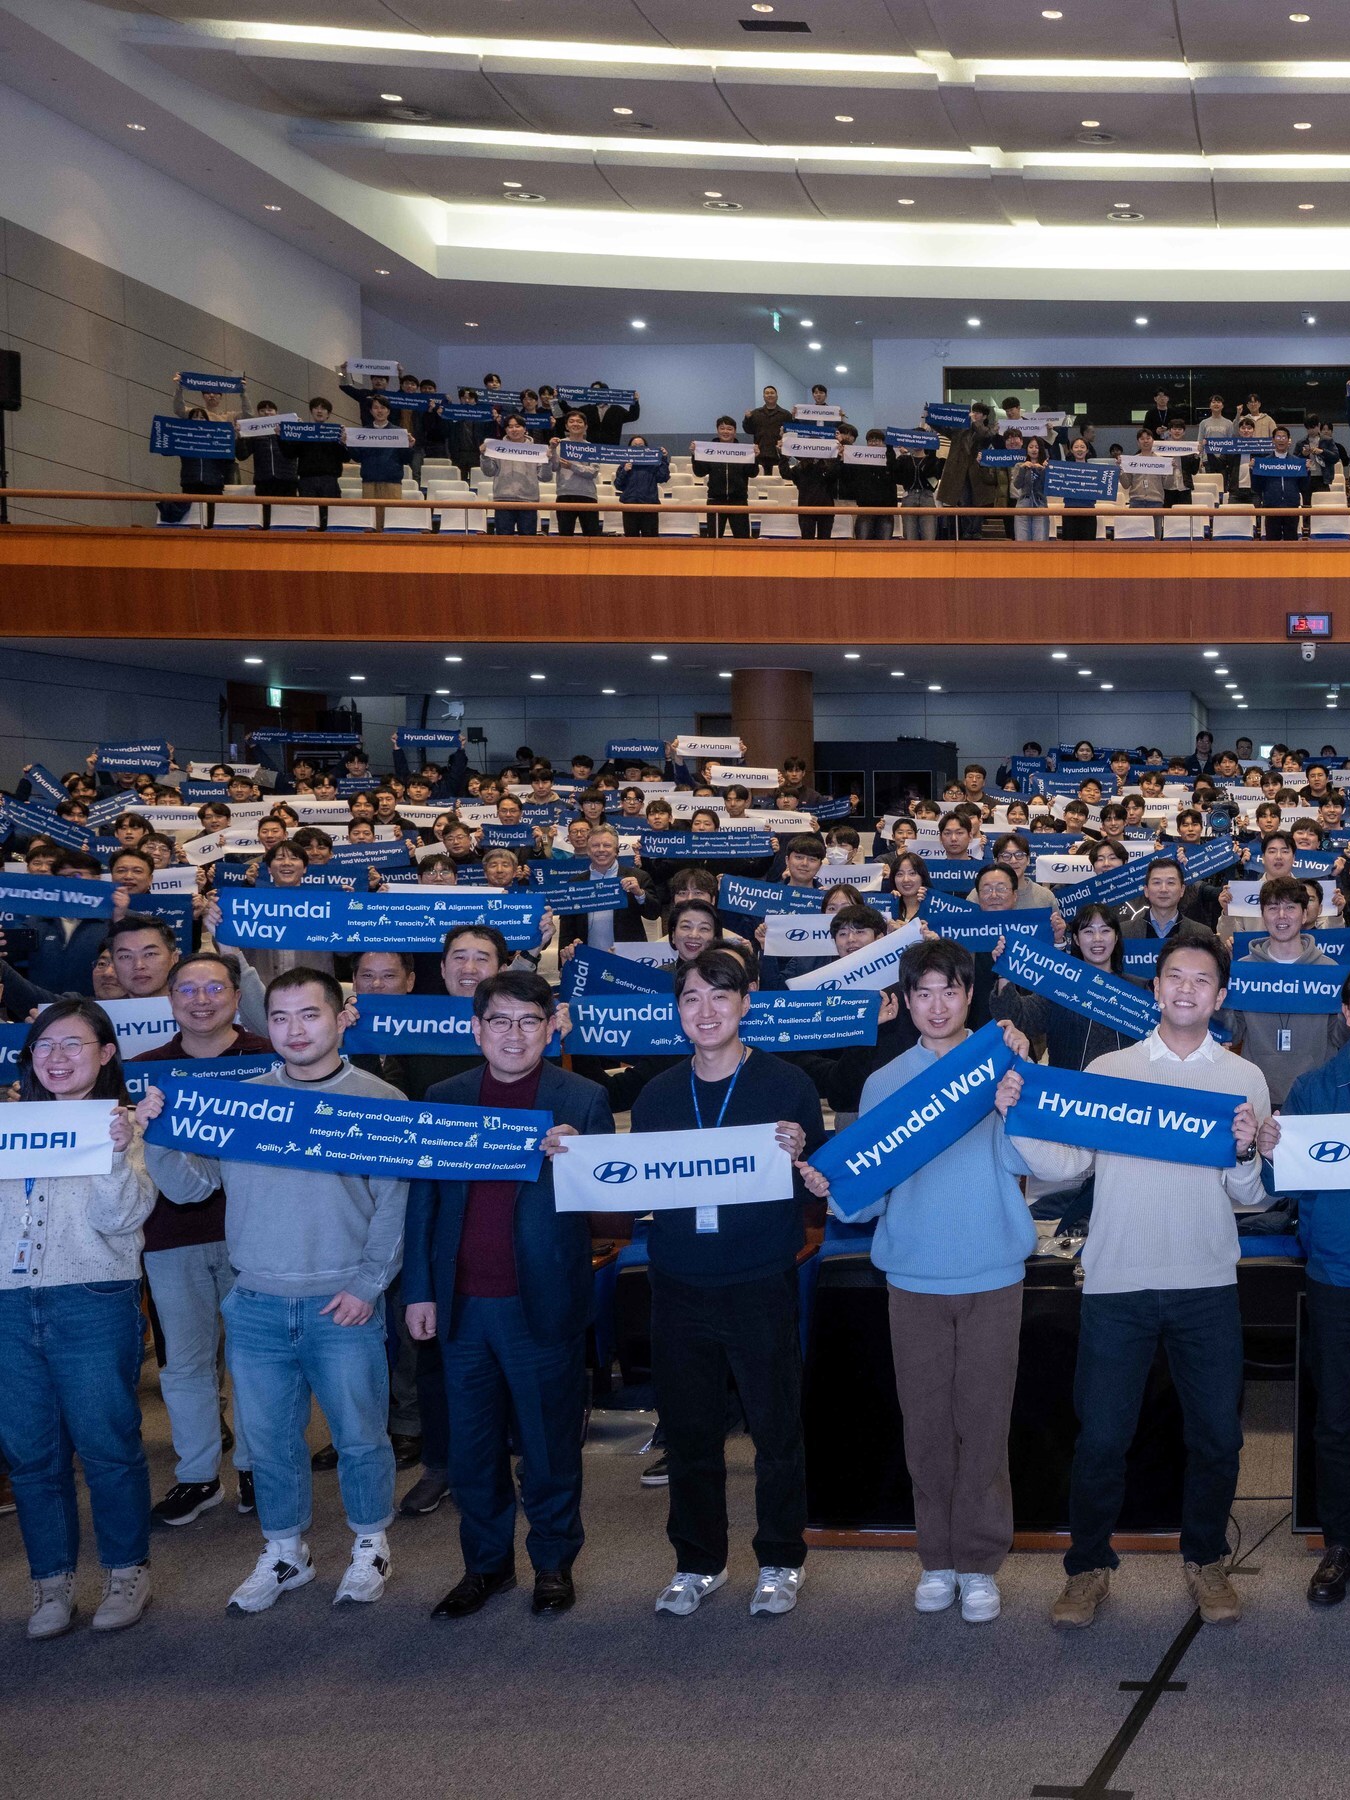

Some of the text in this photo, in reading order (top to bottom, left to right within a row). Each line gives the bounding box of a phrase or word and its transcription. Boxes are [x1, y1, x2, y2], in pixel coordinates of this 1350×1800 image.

[186, 378, 236, 389] Hyundai Way
[283, 424, 316, 434] Hyundai
[284, 430, 302, 439] Way
[565, 444, 596, 454] Hyundai
[1208, 440, 1233, 449] Hyundai
[566, 450, 583, 460] Way
[1259, 463, 1301, 472] Hyundai Way
[404, 733, 454, 742] Hyundai Way
[642, 745, 659, 753] Way
[102, 757, 161, 768] Hyundai Way
[489, 830, 527, 839] Hyundai
[644, 836, 686, 846] Hyundai
[646, 846, 668, 855] Way
[328, 874, 357, 886] Way
[728, 882, 783, 901] Hyundai
[232, 899, 330, 919] Hyundai
[406, 904, 430, 912] Quality
[449, 903, 483, 911] Alignment
[503, 903, 532, 911] Progress
[727, 894, 757, 910] Way
[233, 920, 286, 942] Way
[395, 920, 424, 928] Tenacity
[306, 935, 328, 943] Agility
[1011, 940, 1082, 983] Hyundai
[1008, 957, 1044, 986] Way
[1228, 977, 1342, 998] Hyundai Way
[577, 1002, 673, 1024] Hyundai
[580, 1027, 631, 1047] Way
[174, 1089, 294, 1123] Hyundai
[336, 1109, 364, 1120] Safety
[384, 1114, 414, 1124] Quality
[435, 1118, 478, 1128] Alignment
[502, 1123, 537, 1132] Progress
[845, 1057, 996, 1176] Hyundai Way
[1038, 1090, 1217, 1139] Hyundai Way
[171, 1116, 235, 1147] Way
[309, 1128, 522, 1151] Integrity Tenacity Resilience Expertise
[256, 1143, 283, 1153] Agility
[326, 1150, 376, 1162] Data-Driven
[379, 1155, 414, 1165] Thinking
[437, 1160, 473, 1169] Diversity
[645, 1156, 755, 1180] HYUNDAI
